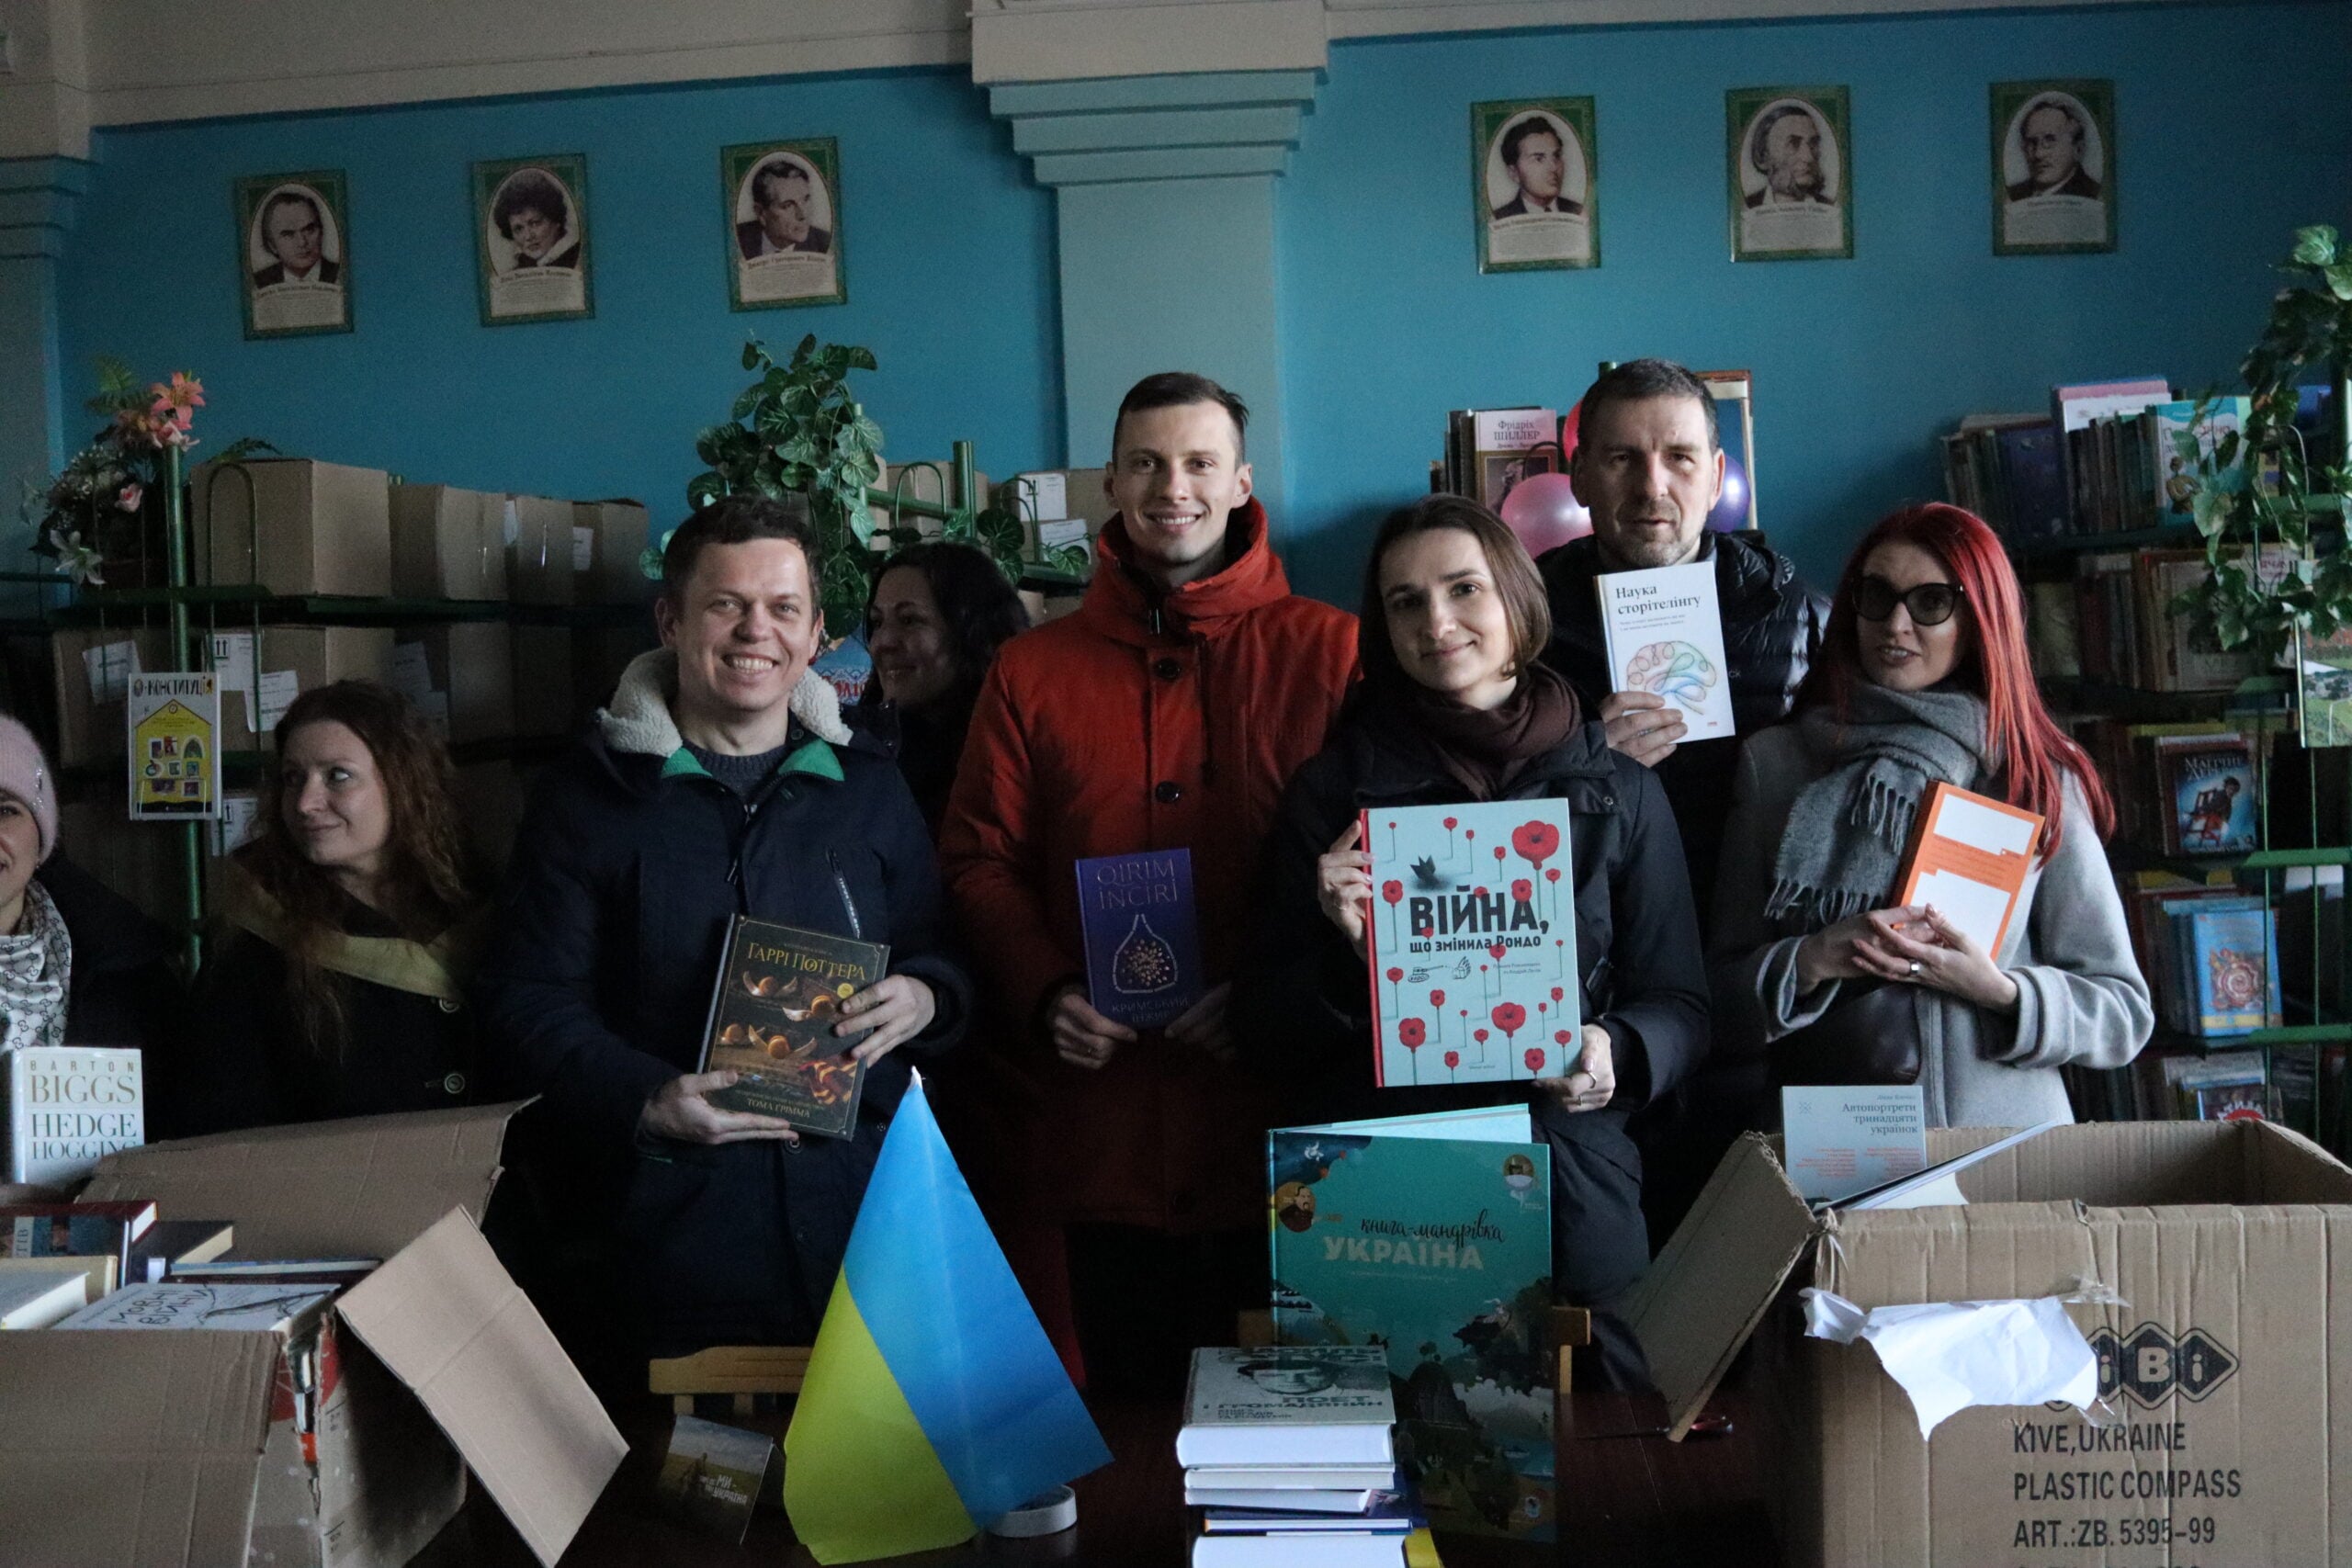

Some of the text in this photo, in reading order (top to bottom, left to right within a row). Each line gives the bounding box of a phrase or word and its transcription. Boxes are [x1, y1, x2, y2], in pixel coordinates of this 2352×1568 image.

[1498, 421, 1534, 430] Фрідріх
[1494, 431, 1540, 441] ШИЛЛЕР
[1615, 585, 1658, 600] Наука
[1617, 595, 1702, 615] сторітелінгу
[1097, 858, 1175, 886] QIRIM
[1409, 885, 1550, 936] ВІЙНА,
[1409, 934, 1542, 953] що змінила Рондо
[791, 952, 866, 981] ПОТТЕРА
[1112, 997, 1188, 1014] КРИМСЬКИЙ
[29, 1060, 134, 1073] BARTON
[30, 1075, 136, 1103] BIGGS
[1842, 1103, 1917, 1113] Автопортрети
[29, 1113, 137, 1138] HEDGE
[1853, 1114, 1917, 1125] тринадцяти
[1871, 1124, 1918, 1136] українок
[1361, 1208, 1505, 1251] книга-мандрівка
[1323, 1235, 1485, 1271] УКРАЇНА
[1282, 1395, 1371, 1404] ПОЕТ
[2013, 1469, 2242, 1501] PLASTIC COMPASS
